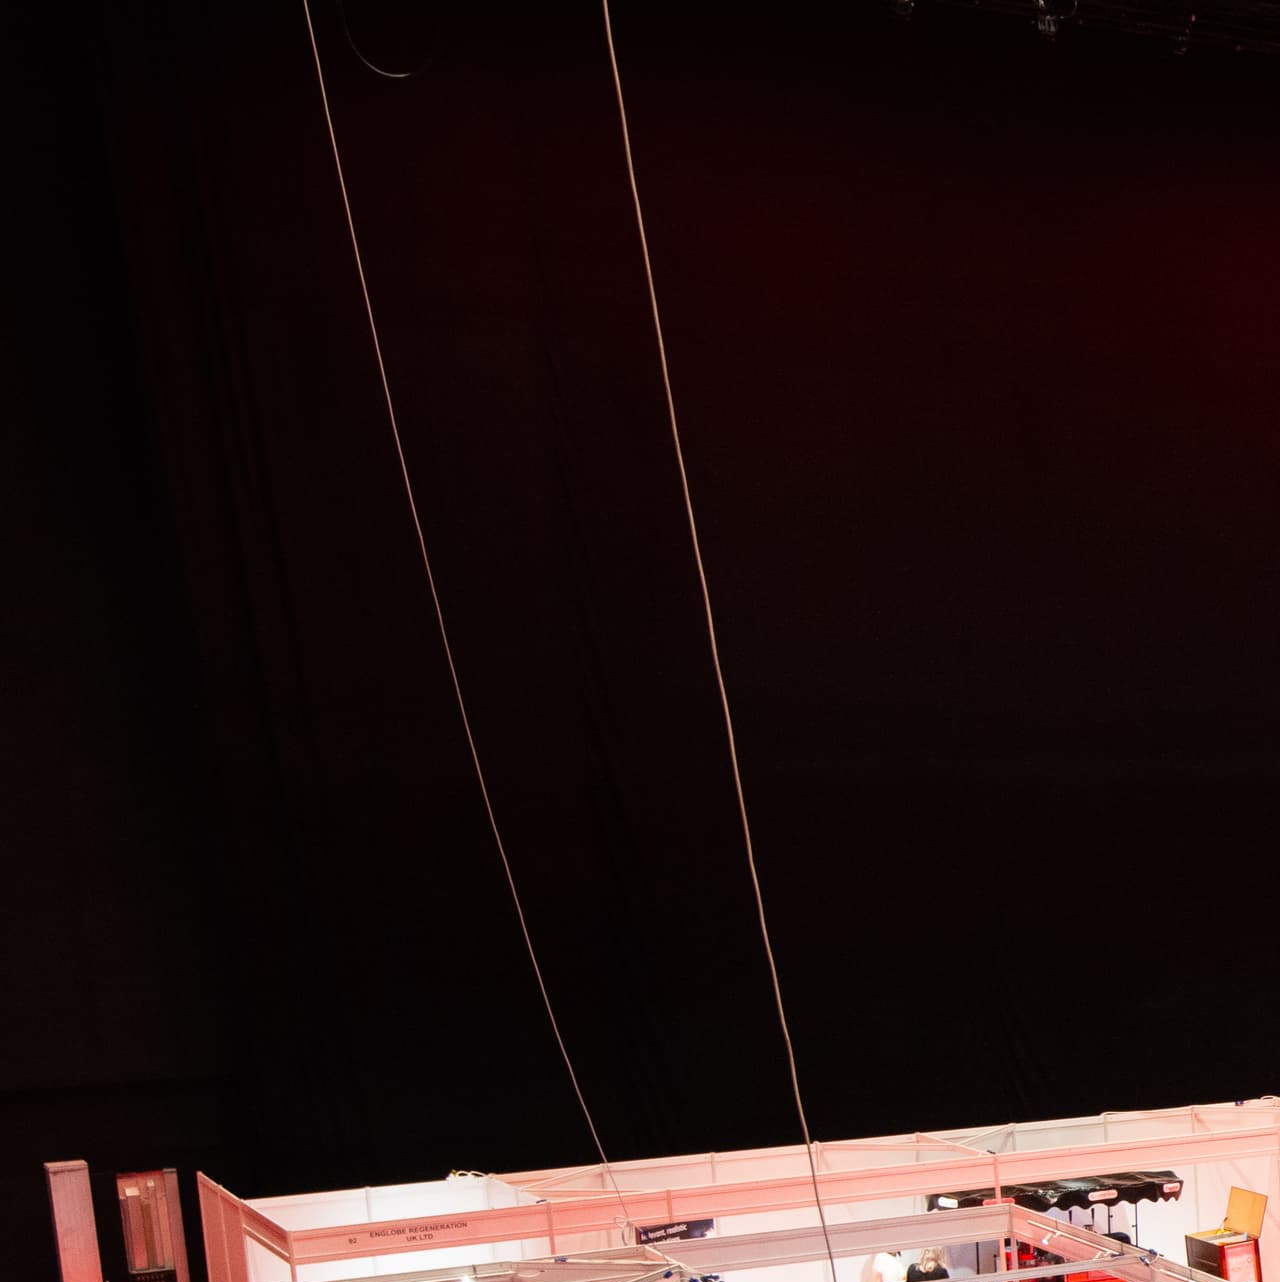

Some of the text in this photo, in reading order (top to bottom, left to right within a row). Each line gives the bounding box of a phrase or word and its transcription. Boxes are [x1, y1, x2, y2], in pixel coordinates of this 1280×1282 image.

[369, 1221, 468, 1239] ENGLOBE REGENERATION
[406, 1232, 434, 1243] UK LTD
